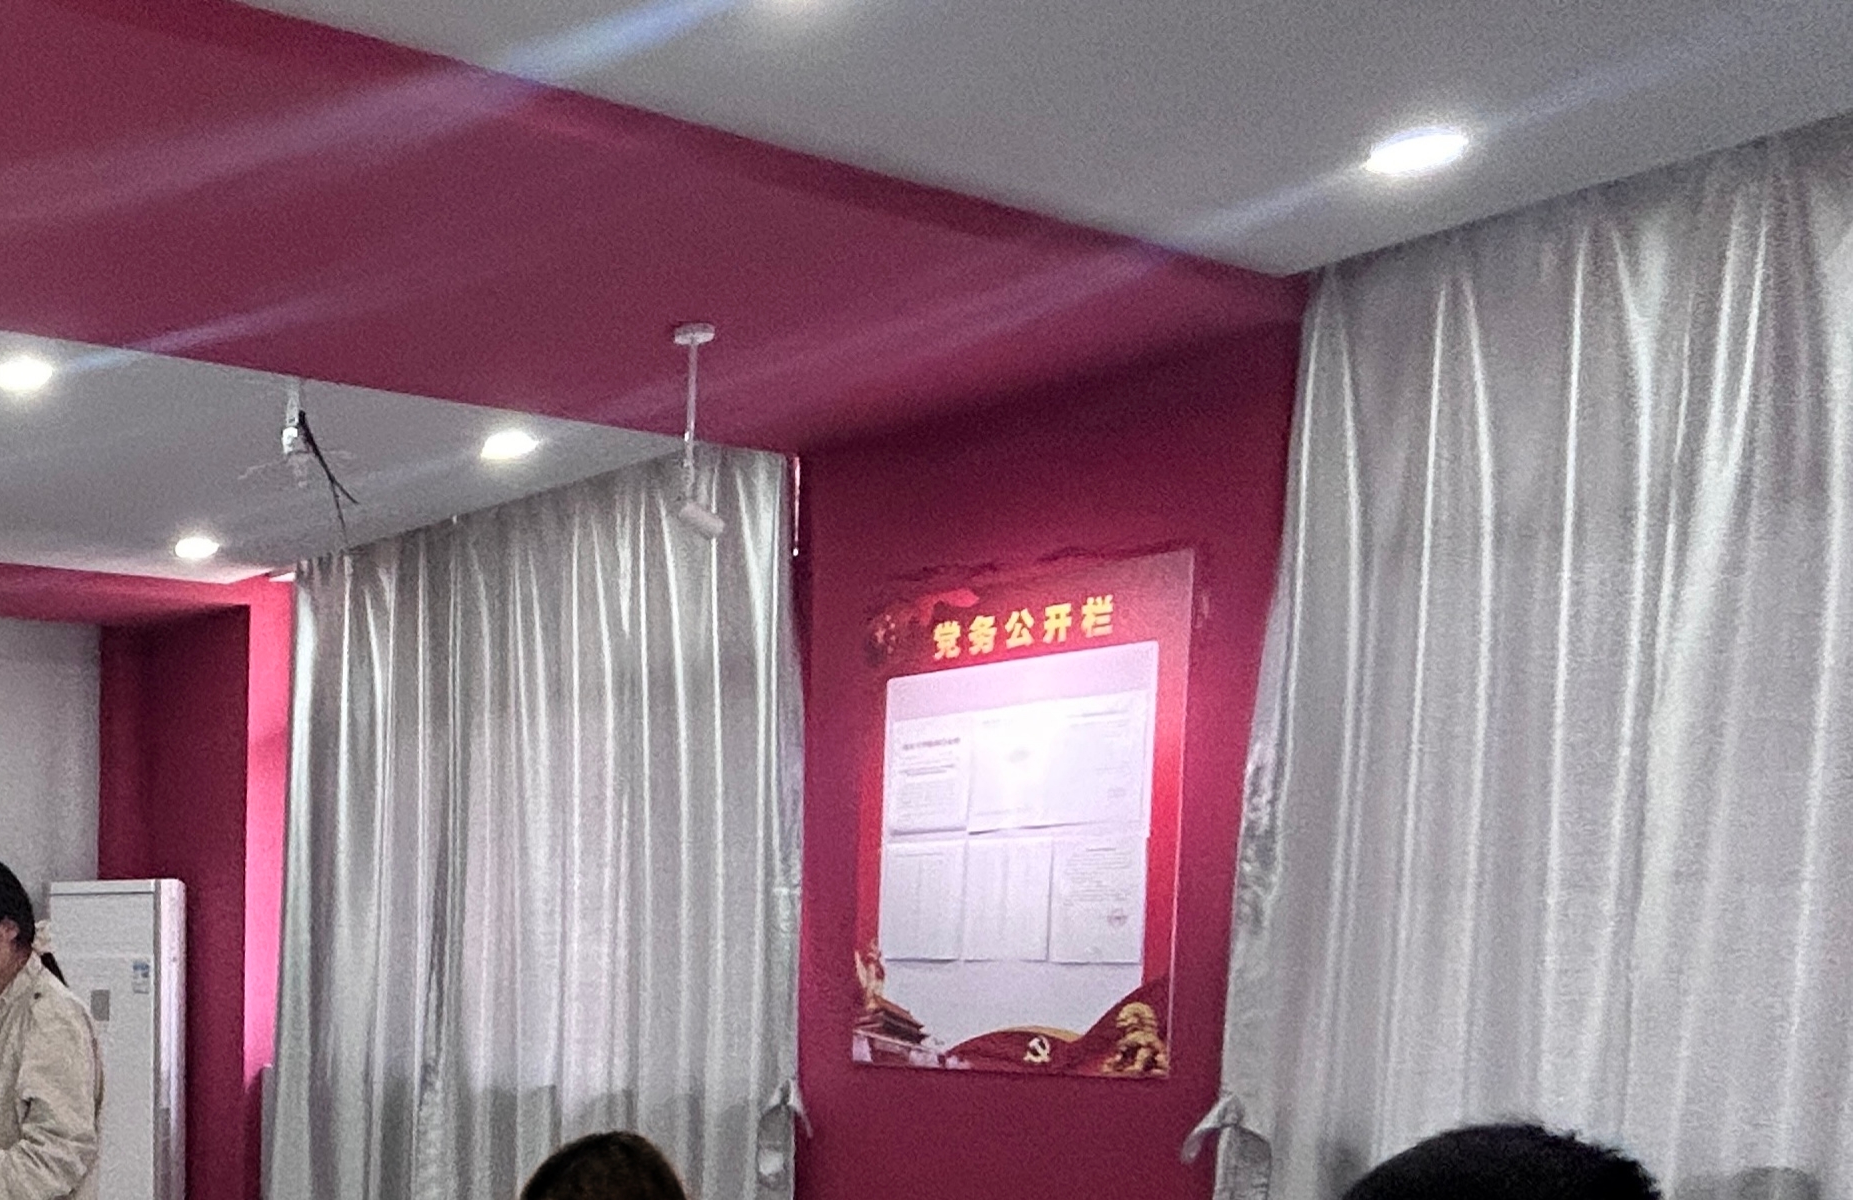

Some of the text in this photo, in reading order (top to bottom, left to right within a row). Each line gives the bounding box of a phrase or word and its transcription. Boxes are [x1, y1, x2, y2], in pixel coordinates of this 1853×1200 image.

[932, 595, 1114, 660] 党务公开栏
